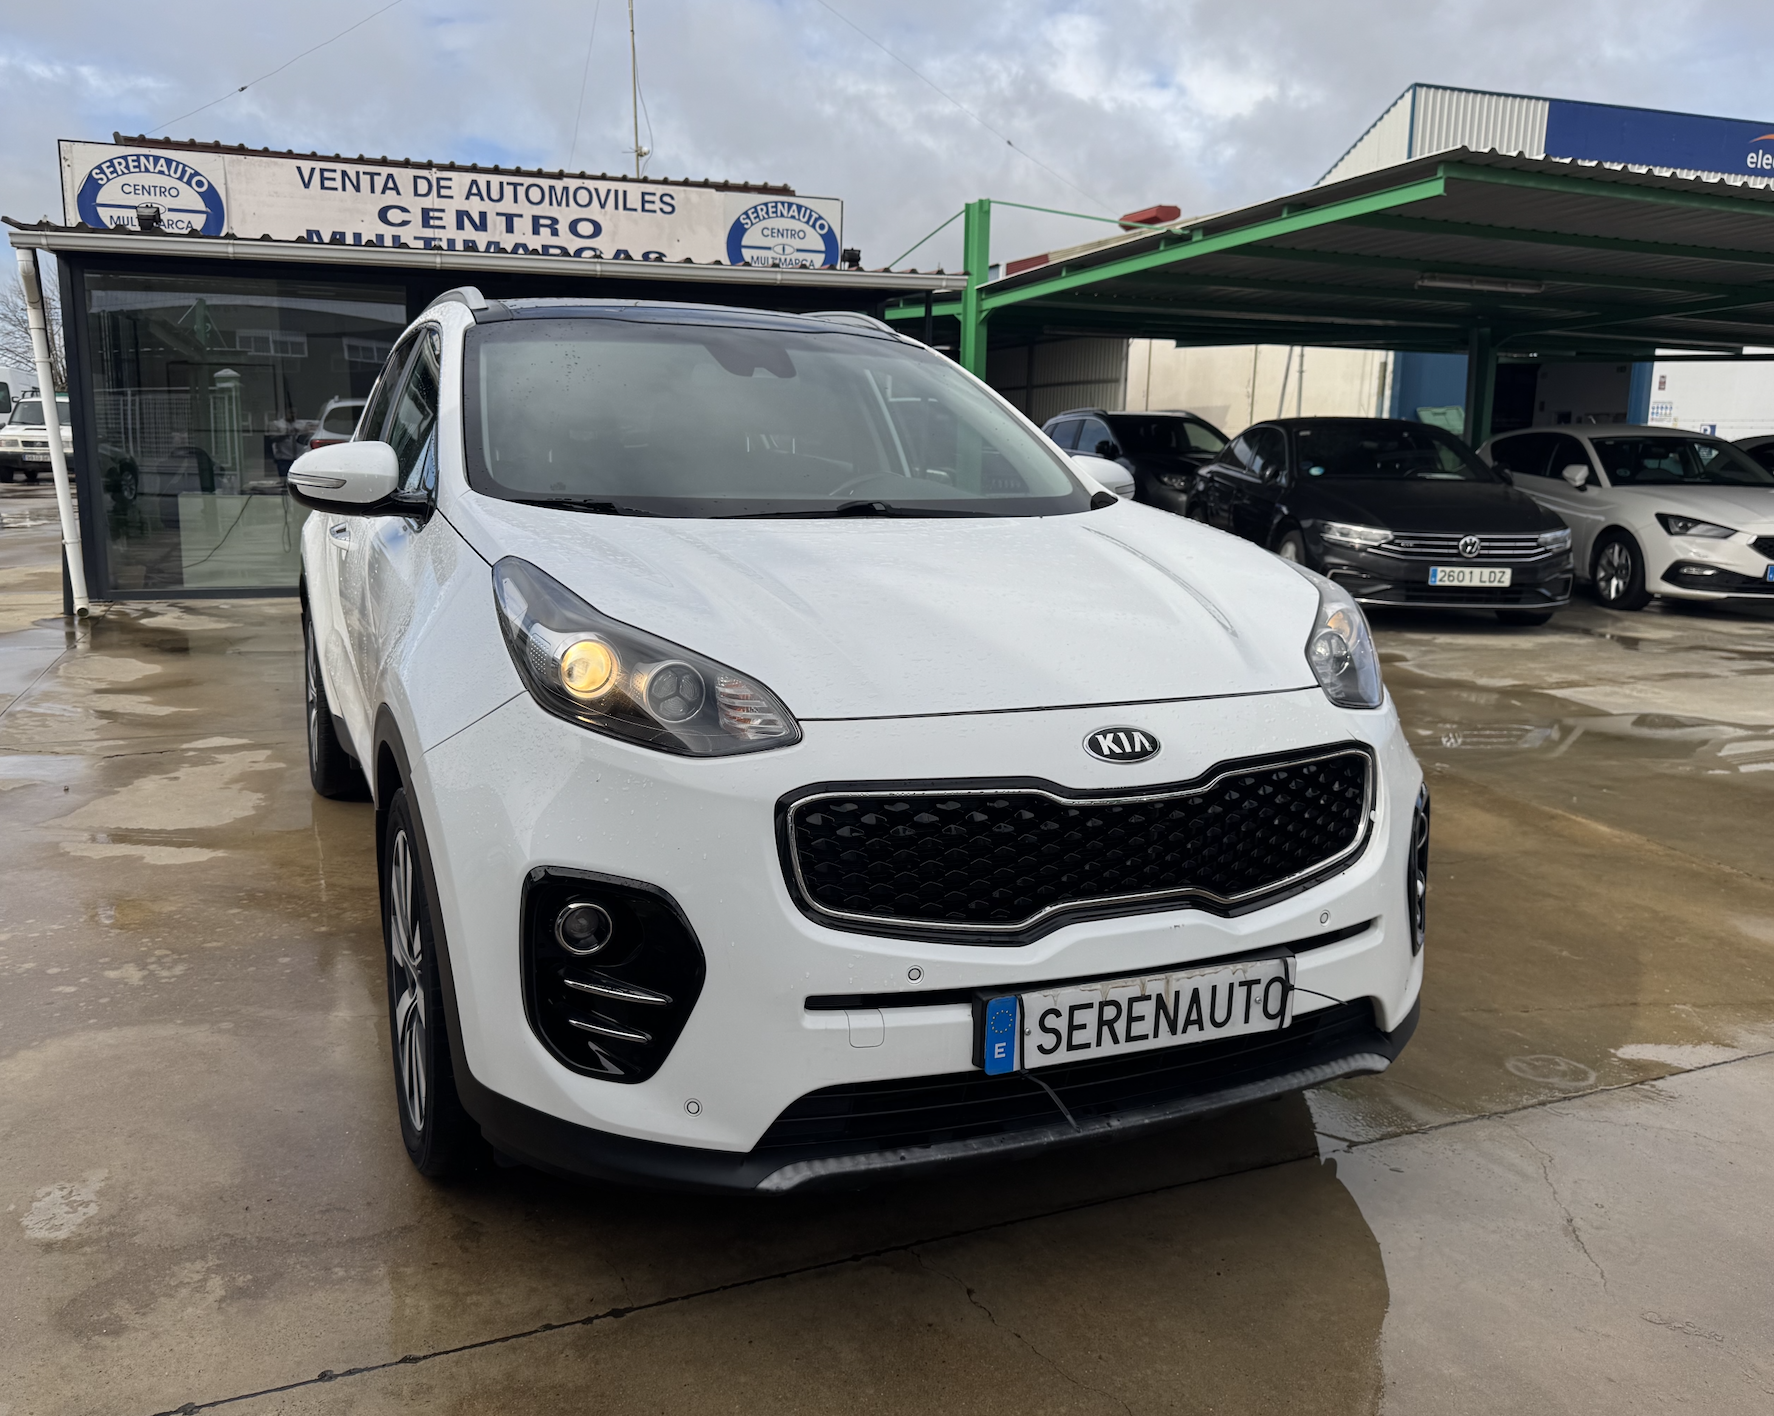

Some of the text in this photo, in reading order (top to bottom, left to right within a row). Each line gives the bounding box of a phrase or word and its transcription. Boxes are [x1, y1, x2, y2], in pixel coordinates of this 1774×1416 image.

[1746, 149, 1774, 169] ele
[92, 155, 209, 193] SERENAUTO
[121, 183, 180, 198] CENTRO
[296, 166, 676, 215] VENTA DE AUTOMOVILES
[109, 215, 194, 231] MULARCA
[377, 204, 602, 239] CENTRO
[740, 202, 829, 235] SERENAUTO
[761, 227, 806, 240] CENTRO
[1438, 570, 1506, 584] 2601 LDZ
[1095, 731, 1154, 755] KIA
[1037, 976, 1287, 1056] SERENAUTO
[994, 1042, 1006, 1059] E
